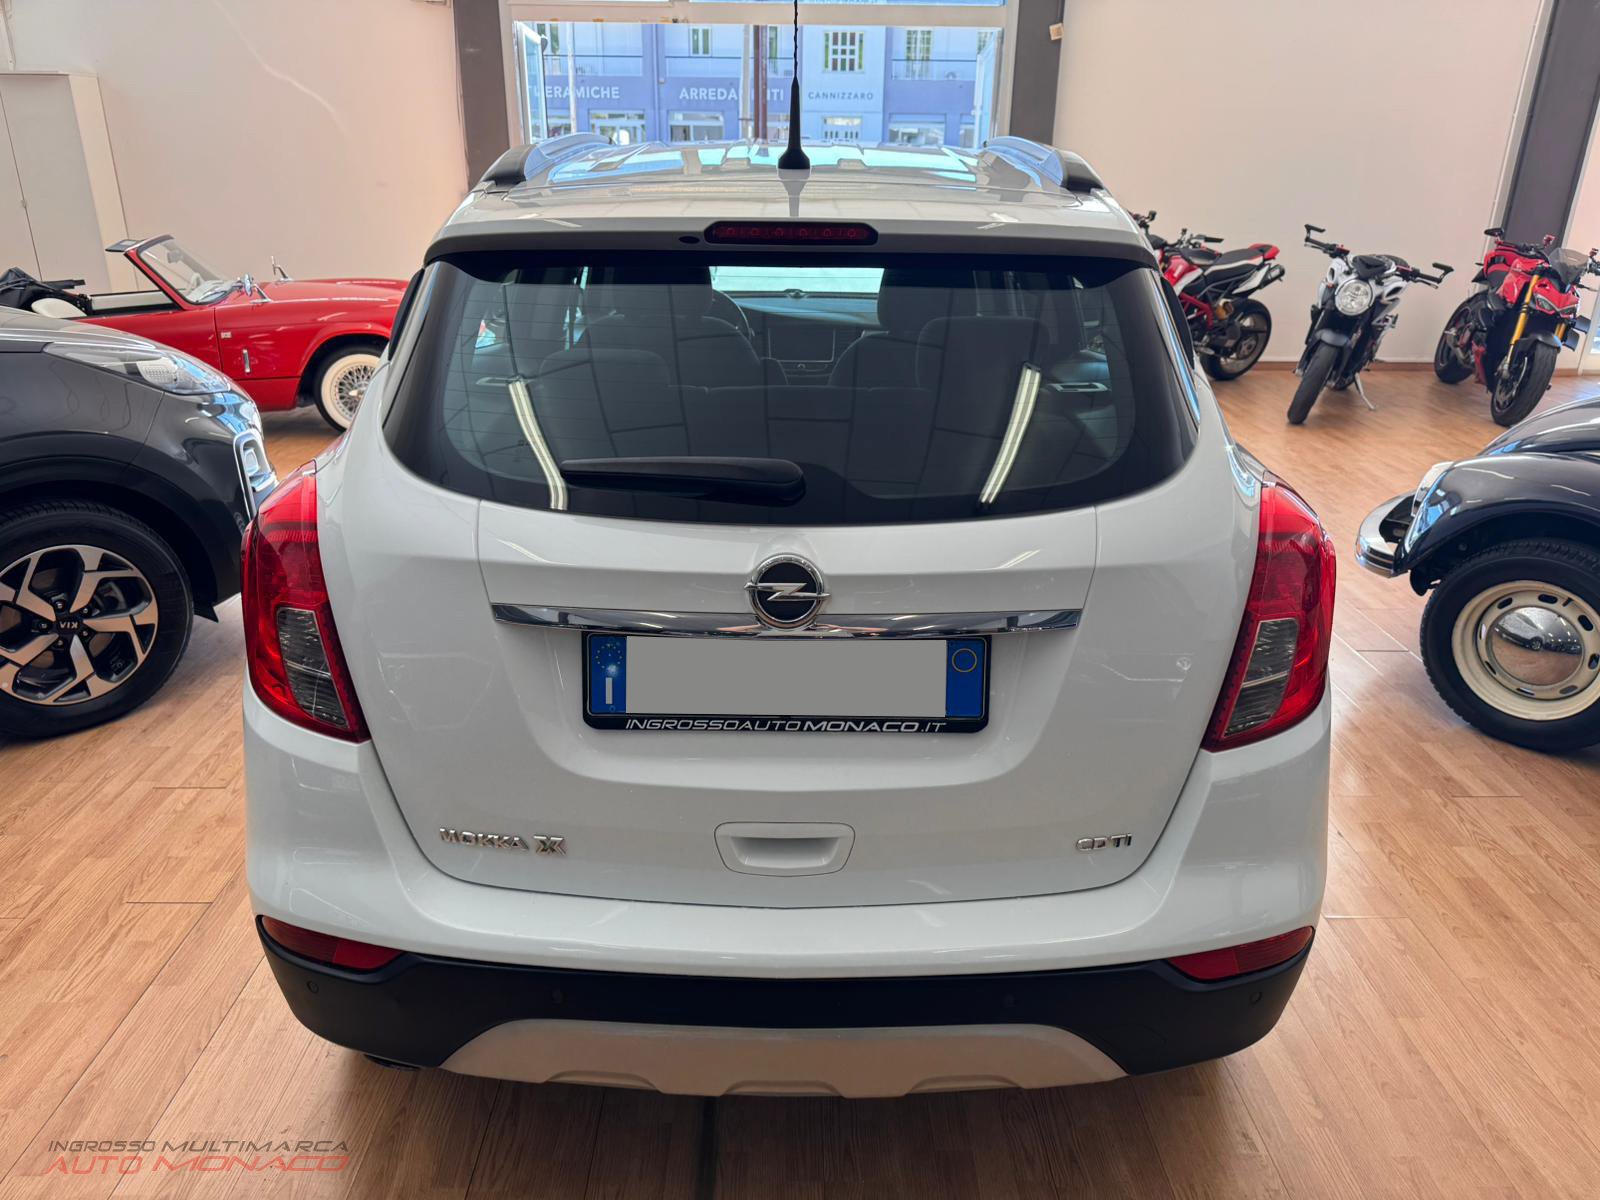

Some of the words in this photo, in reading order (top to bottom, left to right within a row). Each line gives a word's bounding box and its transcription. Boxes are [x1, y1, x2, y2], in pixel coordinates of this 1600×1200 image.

[534, 86, 620, 99] ERAMICHE
[679, 87, 784, 101] ARREDATI
[808, 91, 874, 100] CANNIZZARO
[59, 621, 79, 629] KIA
[439, 828, 530, 851] MOKKA
[533, 835, 567, 857] X
[1076, 832, 1133, 851] CDTI
